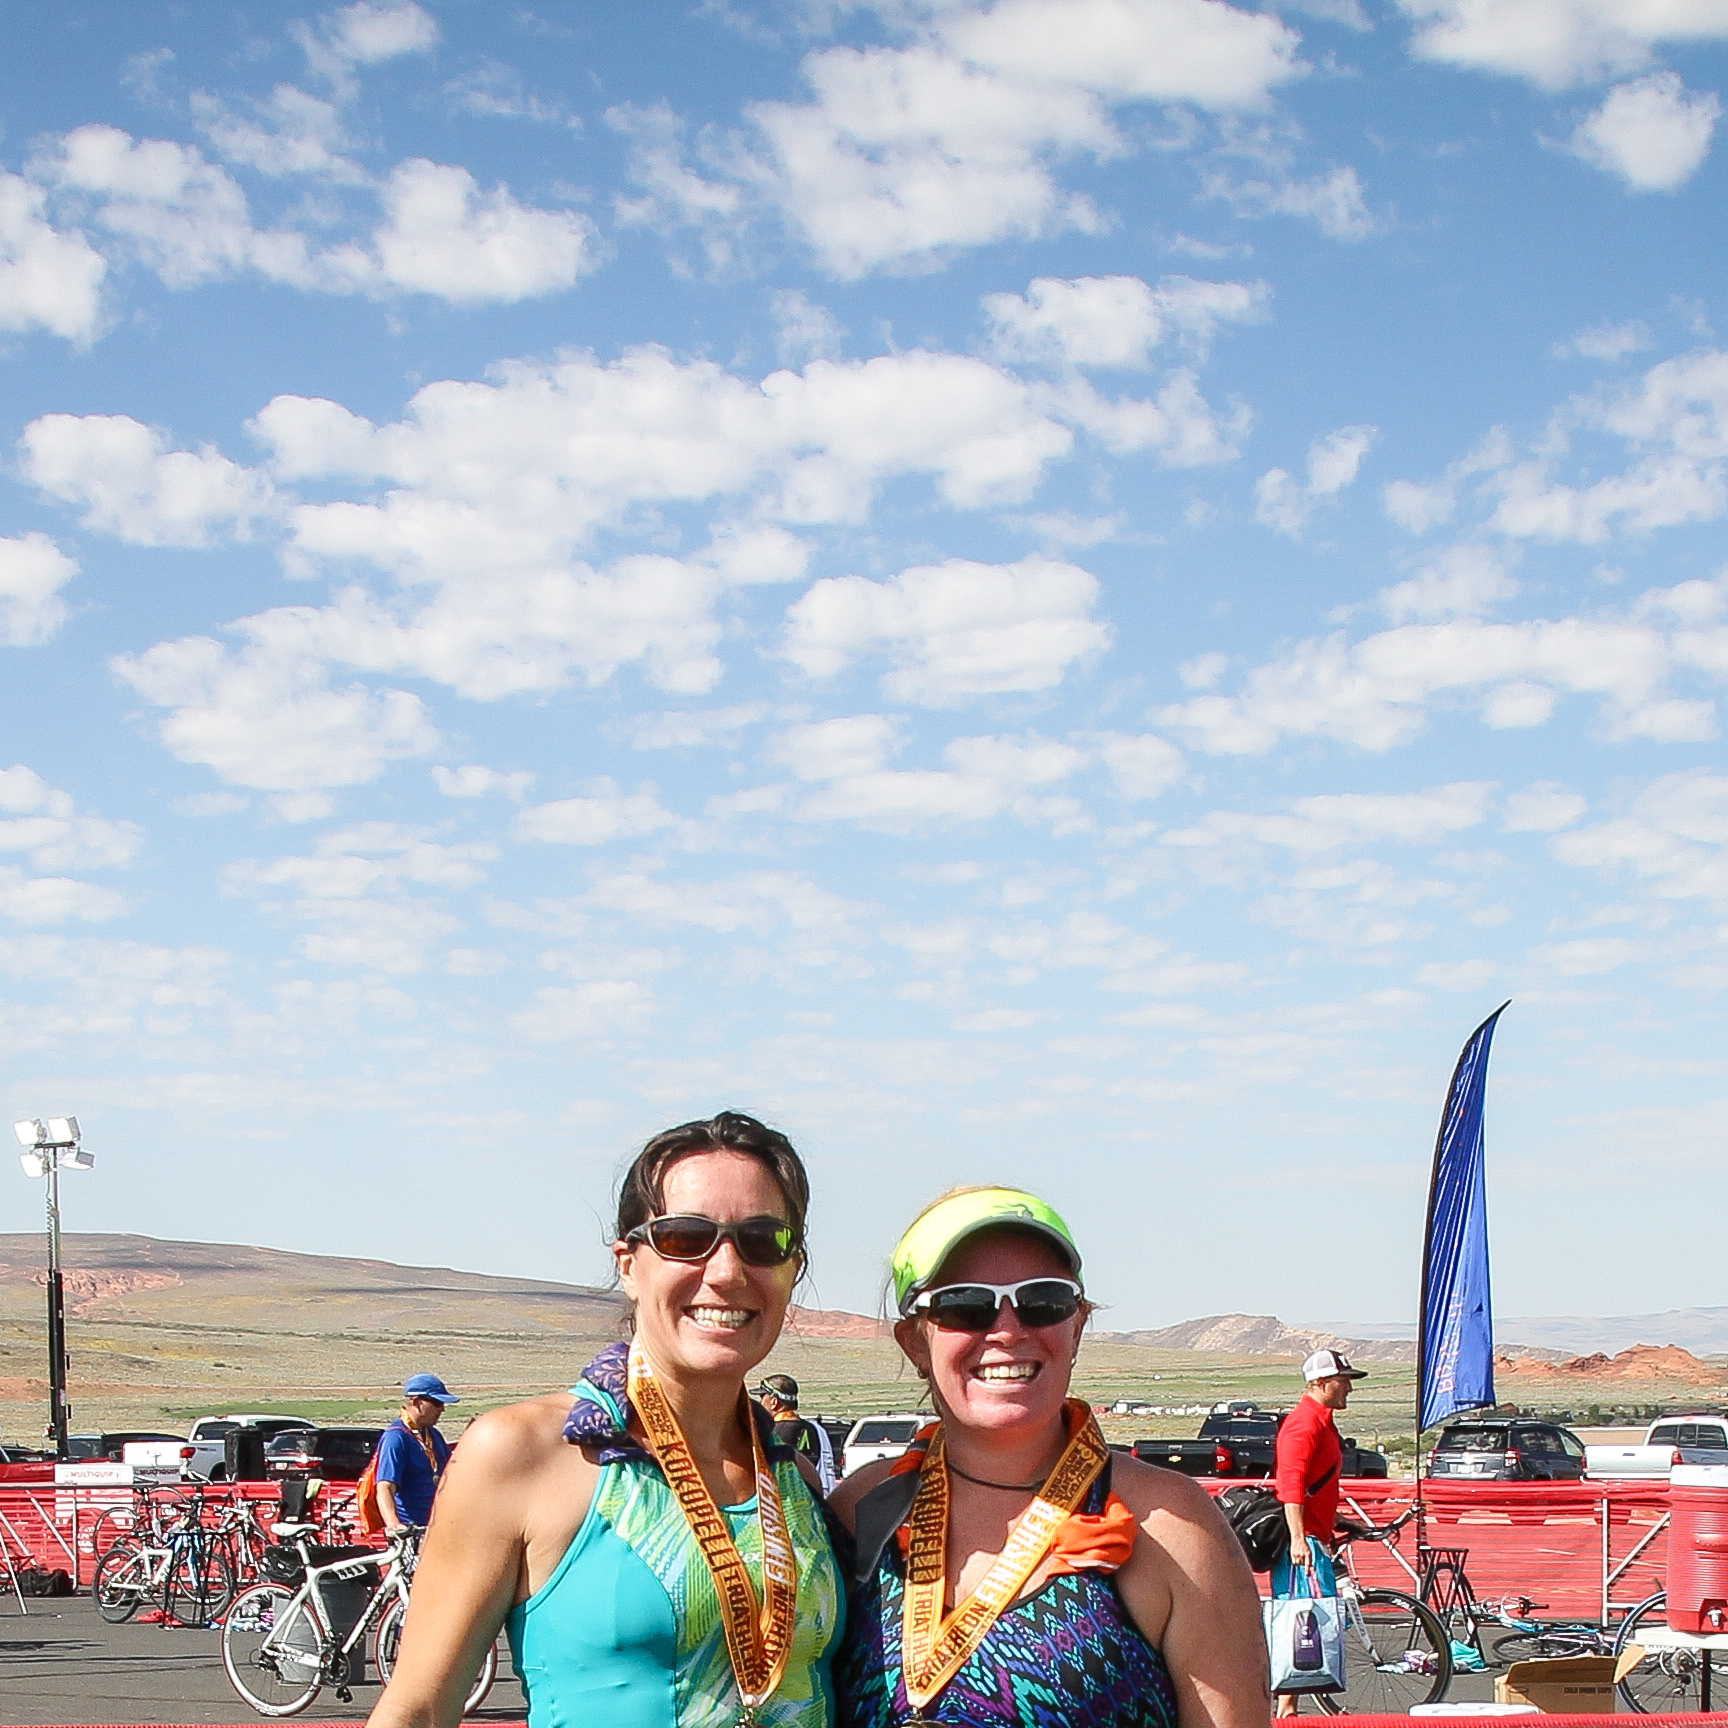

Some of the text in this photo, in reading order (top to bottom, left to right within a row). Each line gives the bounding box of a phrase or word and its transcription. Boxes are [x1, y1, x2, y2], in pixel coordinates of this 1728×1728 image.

[656, 1441, 758, 1688] KOKOPELLI TRIATHLO
[759, 1475, 794, 1586] FINISHER
[909, 1459, 947, 1585] KOKOPELLI
[975, 1498, 1064, 1604] FINISHER
